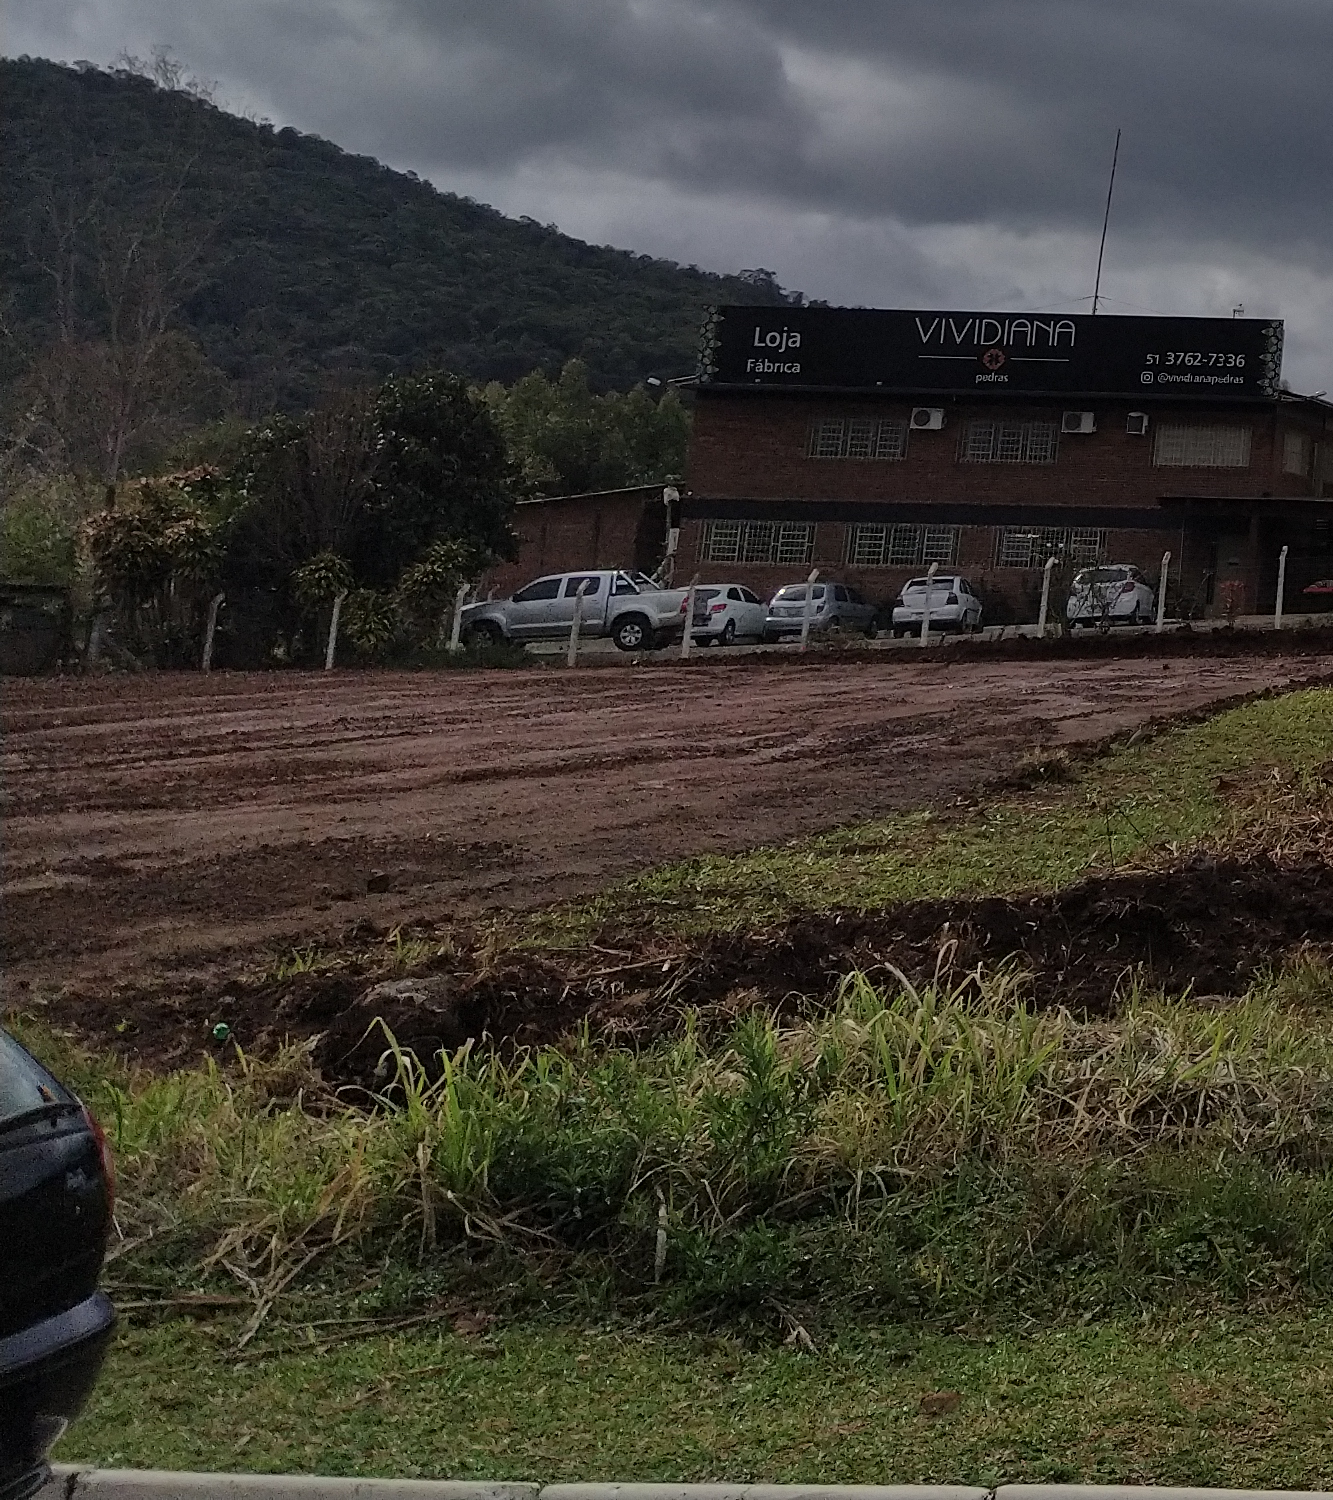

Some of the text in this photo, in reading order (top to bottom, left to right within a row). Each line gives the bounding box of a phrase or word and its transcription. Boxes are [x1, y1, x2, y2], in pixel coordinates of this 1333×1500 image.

[753, 326, 801, 353] Loja
[915, 317, 1076, 347] VIVIDIANA
[746, 359, 801, 374] Fábrica
[1145, 351, 1246, 368] 51 3762-7336
[975, 371, 1009, 384] pedras
